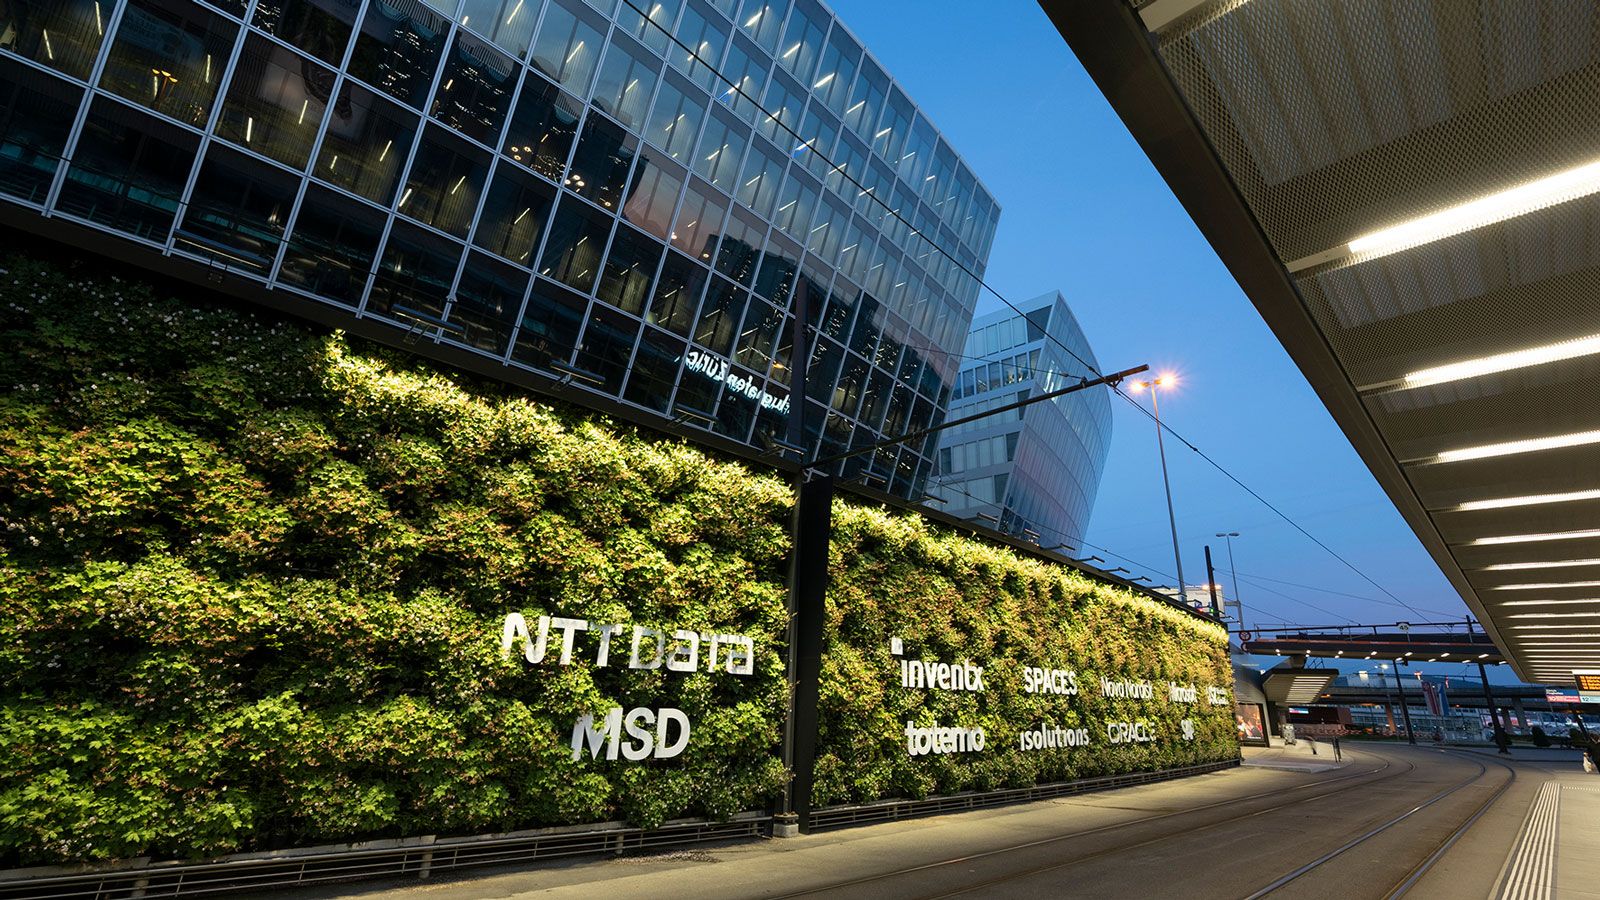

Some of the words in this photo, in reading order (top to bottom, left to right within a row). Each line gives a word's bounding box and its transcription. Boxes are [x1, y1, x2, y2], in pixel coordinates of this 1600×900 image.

[502, 612, 622, 667] NTT
[891, 637, 984, 691] inventx
[1023, 666, 1078, 695] SPACES
[570, 707, 691, 761] MSD
[904, 720, 985, 756] totemo
